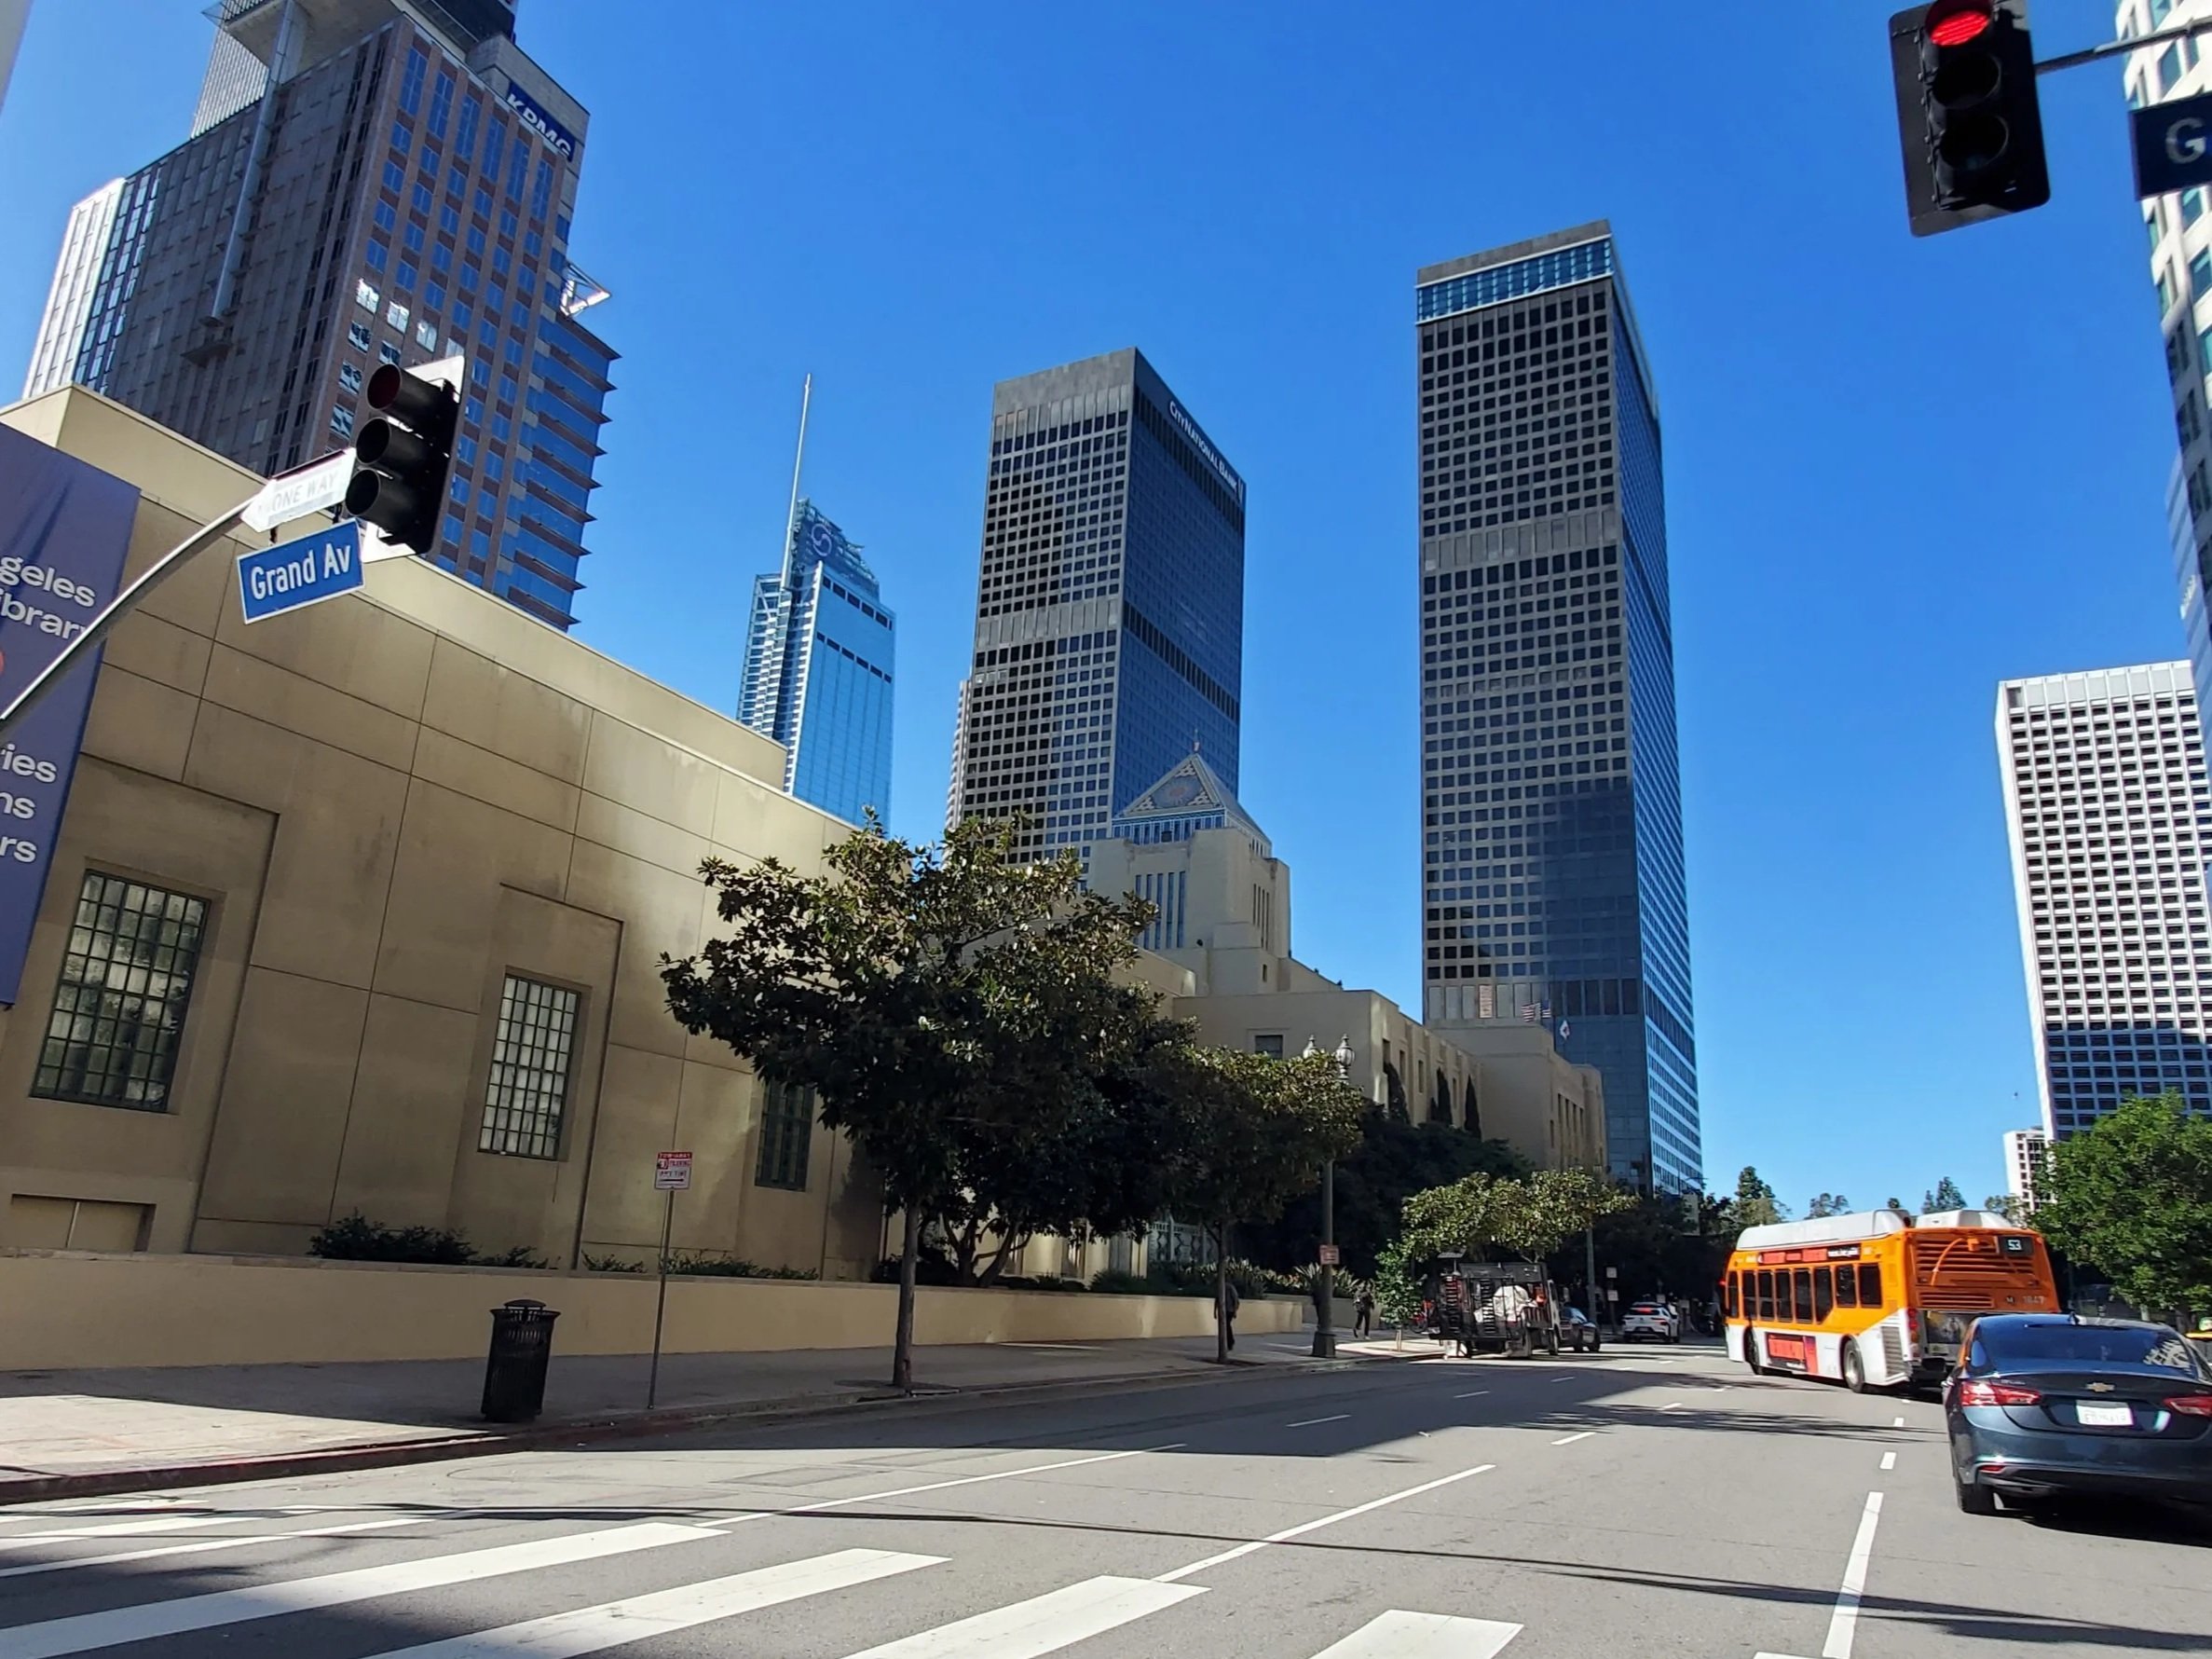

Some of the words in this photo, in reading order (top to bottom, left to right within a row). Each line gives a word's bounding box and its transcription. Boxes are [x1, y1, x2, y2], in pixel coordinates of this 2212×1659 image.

[507, 93, 571, 156] KPMG
[2164, 117, 2207, 164] G
[272, 485, 303, 512] ONE
[307, 472, 338, 499] WAY
[1219, 459, 1237, 489] BANK
[0, 556, 96, 608] geles
[251, 549, 316, 601] Grand
[323, 543, 351, 579] Av
[2007, 1239, 2023, 1251] 53
